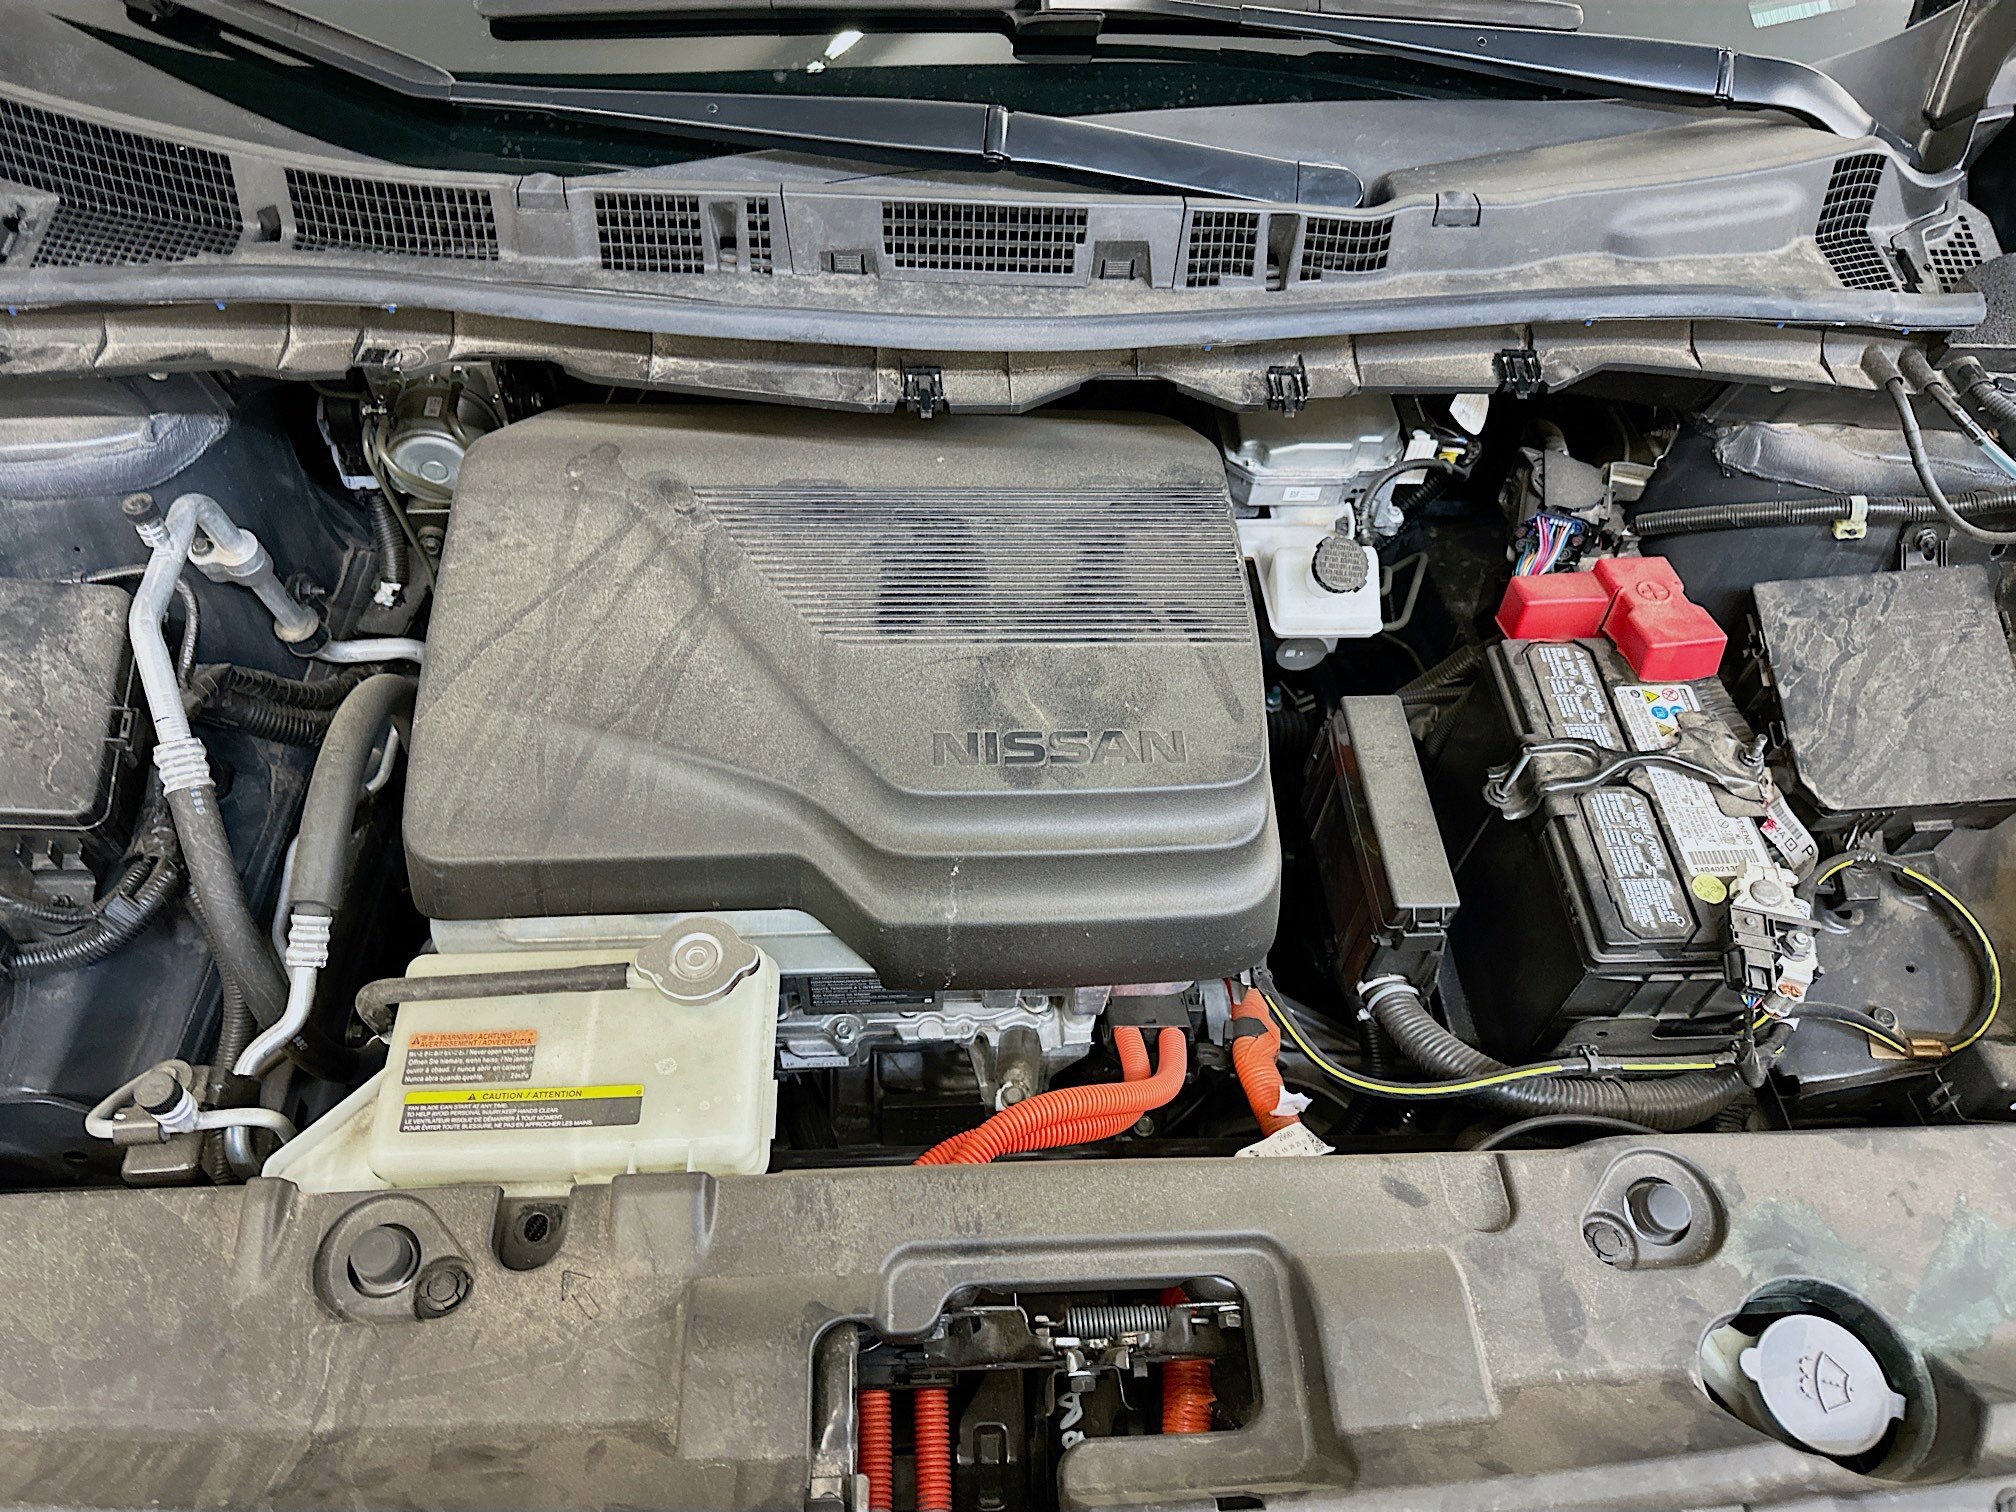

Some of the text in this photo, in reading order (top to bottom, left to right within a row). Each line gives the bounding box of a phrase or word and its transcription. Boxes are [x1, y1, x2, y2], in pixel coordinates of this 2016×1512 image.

[932, 730, 1188, 767] NISSAN
[441, 1033, 473, 1041] WARNING
[478, 1032, 513, 1040] ACHTUNG
[420, 1040, 477, 1048] AVERTISSEMENT
[482, 1091, 523, 1101] CAUTION
[532, 1089, 583, 1099] ATTENTION
[450, 1108, 481, 1117] PERSONAL
[413, 1117, 451, 1125] VENTILATEUR
[451, 1116, 473, 1124] RISQUE
[403, 1124, 421, 1132] POUR
[525, 1120, 561, 1128] APPROCHER
